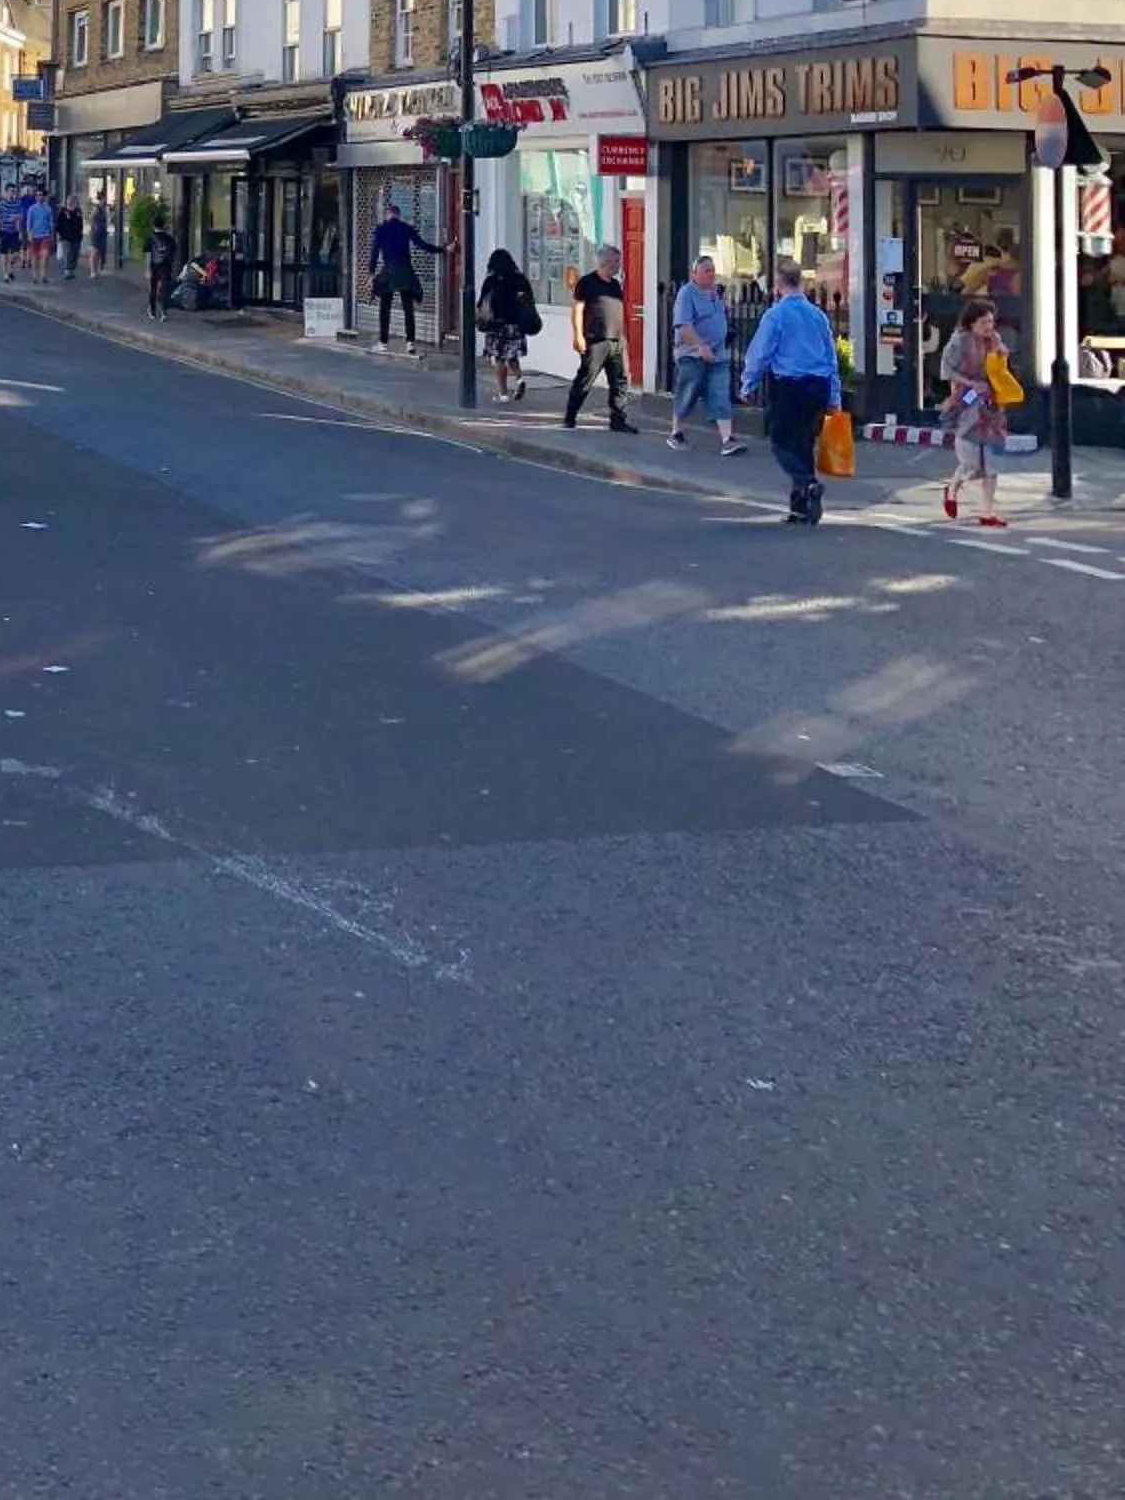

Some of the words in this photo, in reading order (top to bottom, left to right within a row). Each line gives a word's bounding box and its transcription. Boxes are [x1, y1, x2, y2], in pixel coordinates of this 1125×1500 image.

[658, 76, 703, 124] BIG
[712, 67, 786, 121] JIMS
[795, 55, 900, 114] TRIMS
[953, 51, 1053, 114] BIG
[954, 245, 980, 258] OPEN
